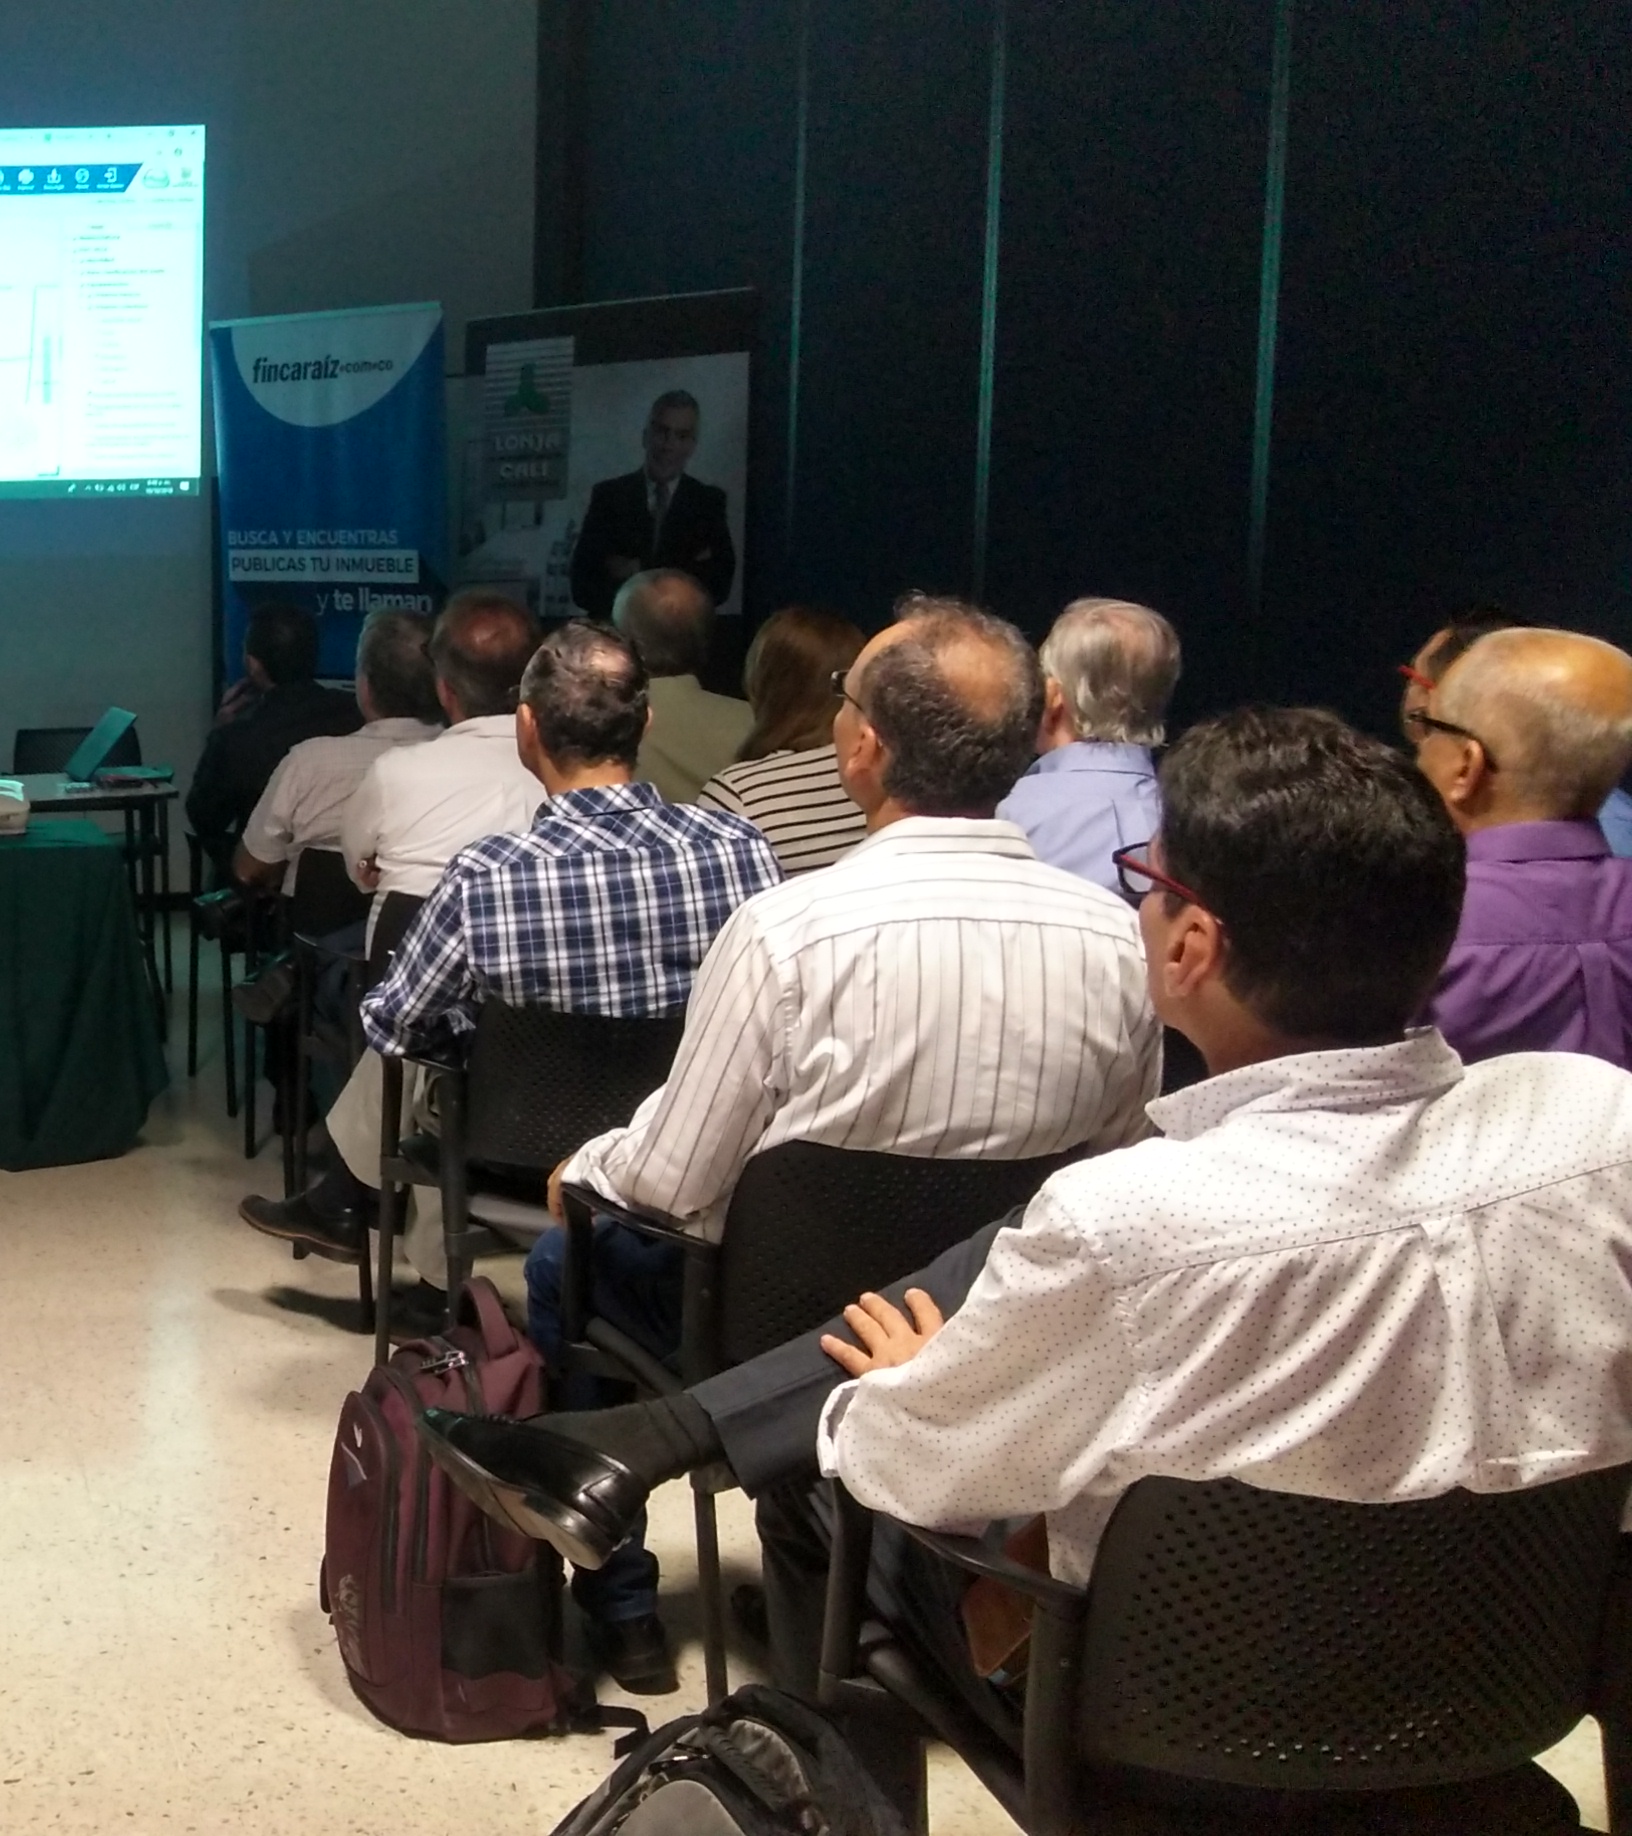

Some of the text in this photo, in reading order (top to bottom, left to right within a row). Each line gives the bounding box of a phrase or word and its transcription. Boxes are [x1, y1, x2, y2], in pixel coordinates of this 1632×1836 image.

[228, 529, 398, 546] BUSCA Y ENCUENTRAS
[231, 557, 306, 572] PUBLICAS
[336, 557, 414, 573] INMUEBLE
[316, 586, 433, 616] y te llaman
